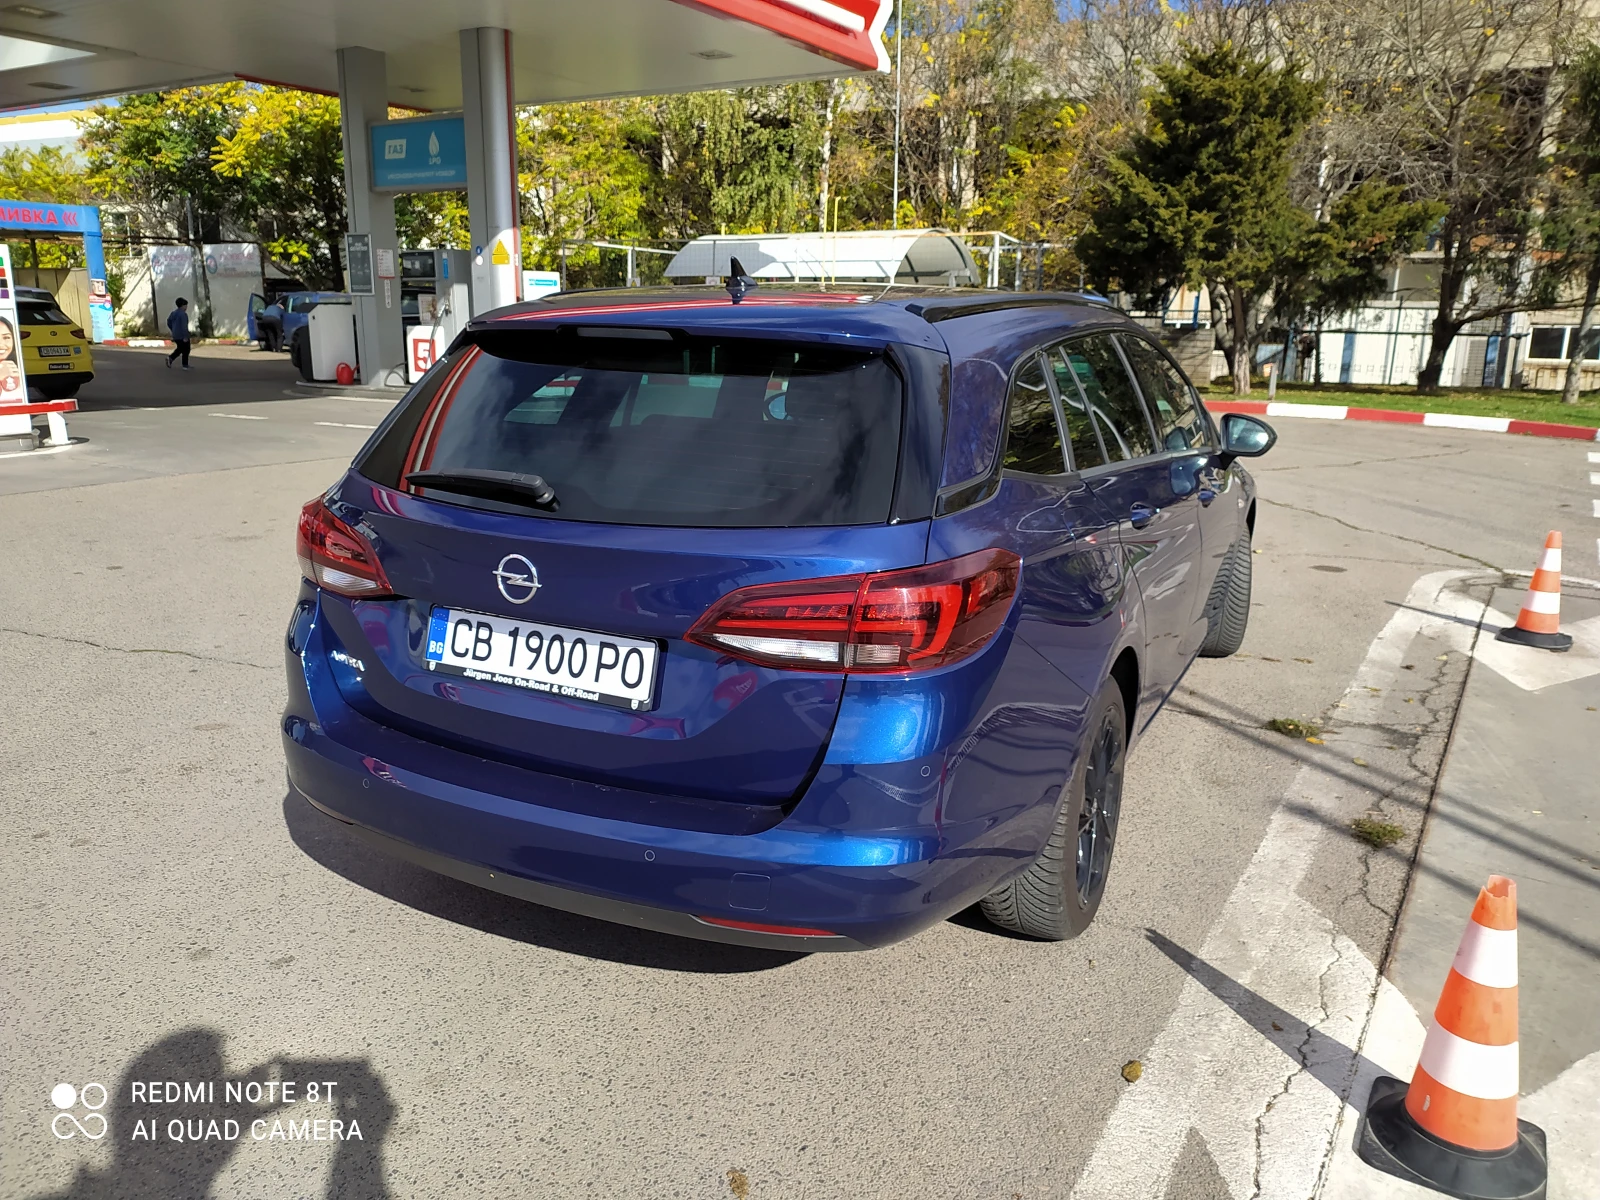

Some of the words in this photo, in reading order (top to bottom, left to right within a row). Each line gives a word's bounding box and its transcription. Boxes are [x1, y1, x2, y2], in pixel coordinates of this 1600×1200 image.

[388, 144, 404, 154] ГАЗ
[417, 341, 431, 370] 5
[429, 640, 444, 654] BG
[451, 619, 493, 661] CB
[508, 627, 587, 678] 1900
[594, 641, 644, 689] PO
[463, 668, 491, 680] Jürgen
[493, 673, 513, 684] Joos
[514, 678, 550, 691] On-Road
[552, 685, 559, 693] &
[561, 686, 599, 701] Off-Road
